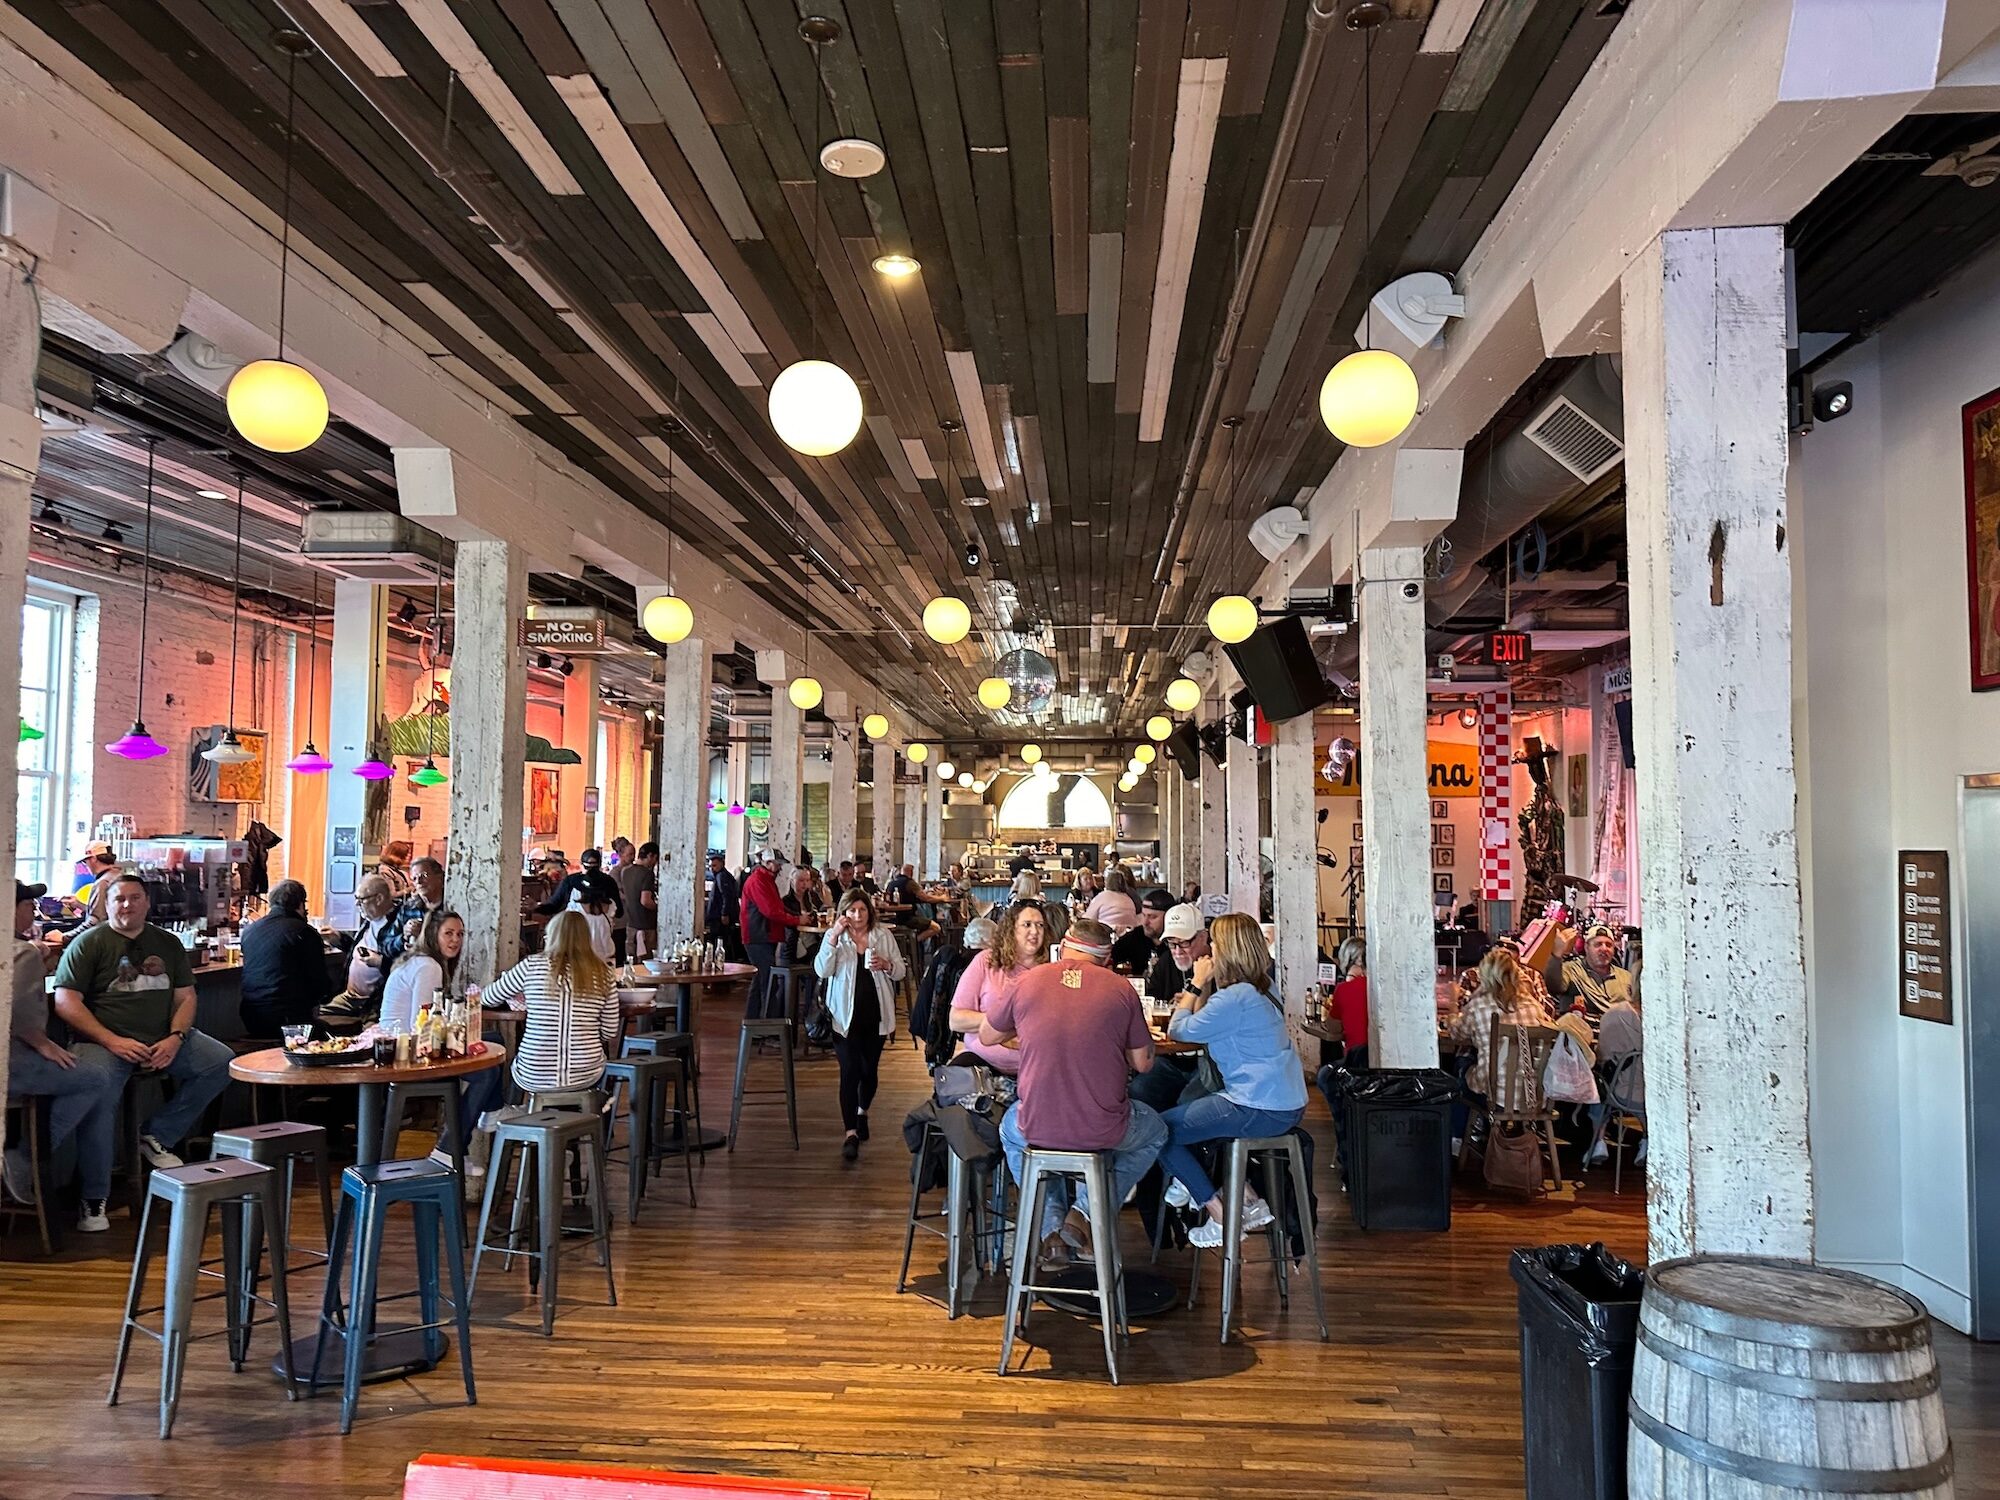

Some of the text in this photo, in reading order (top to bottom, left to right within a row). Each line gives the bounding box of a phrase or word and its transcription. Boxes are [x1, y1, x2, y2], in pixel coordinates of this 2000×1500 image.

[546, 622, 574, 632] NO
[527, 632, 594, 643] SMOKING
[1493, 635, 1526, 660] EXIT
[1608, 671, 1632, 688] MUS
